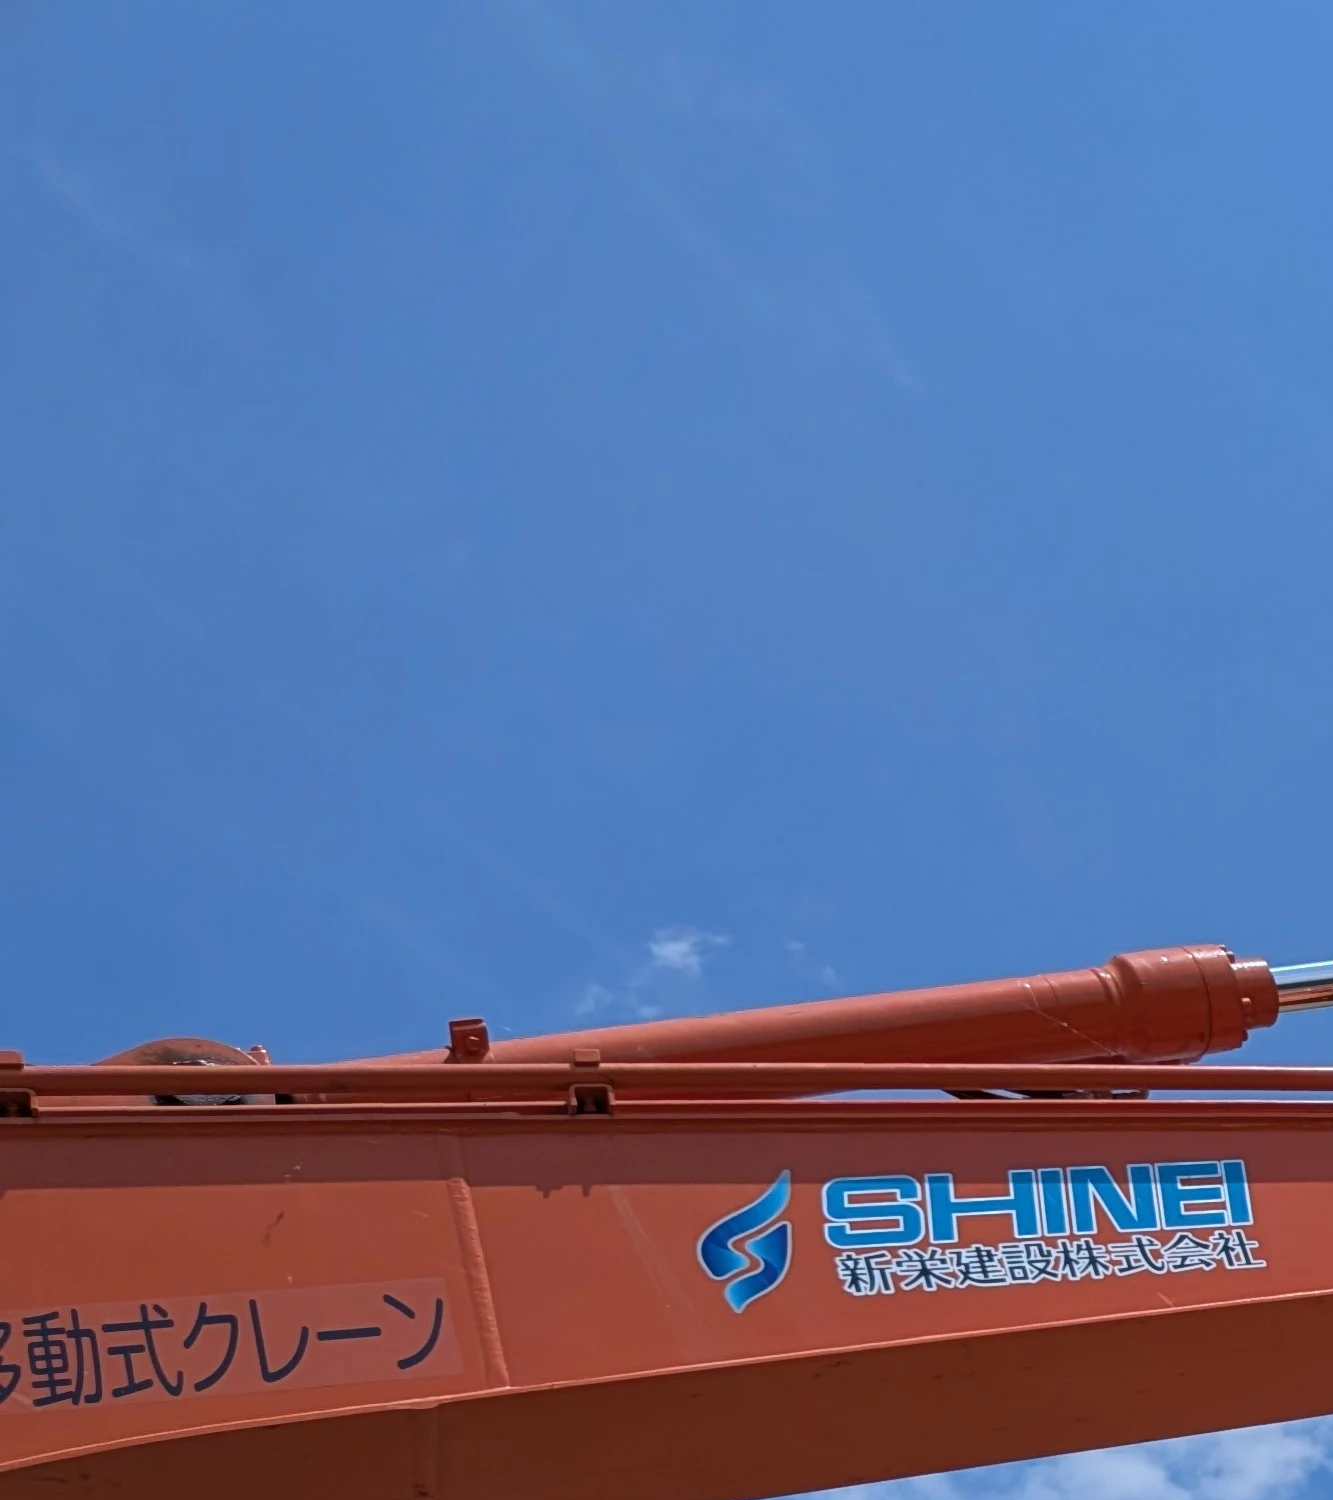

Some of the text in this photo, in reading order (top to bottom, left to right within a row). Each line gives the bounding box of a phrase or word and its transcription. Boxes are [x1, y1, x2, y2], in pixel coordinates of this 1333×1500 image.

[823, 1160, 1254, 1247] SHINEI
[837, 1230, 1266, 1296] 新栄建設株式会社
[0, 1295, 444, 1406] 動式クレーン
